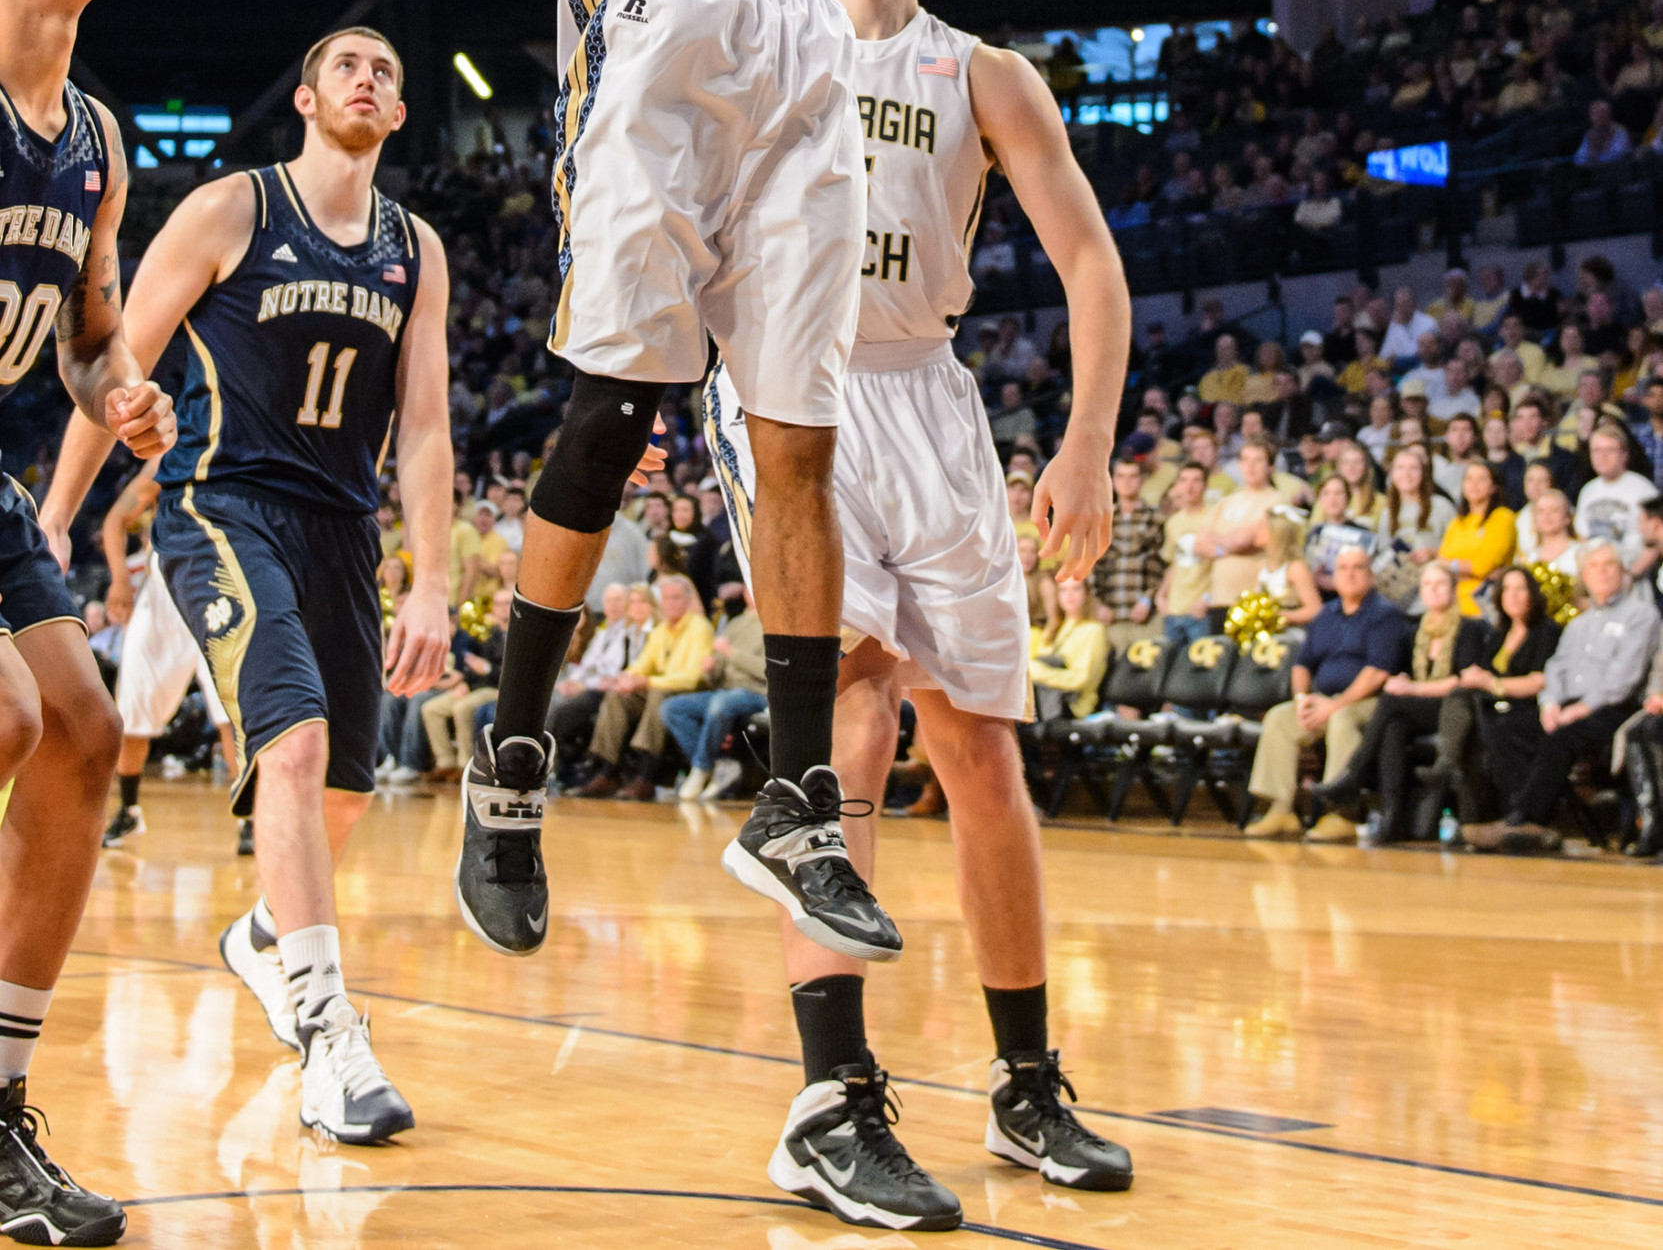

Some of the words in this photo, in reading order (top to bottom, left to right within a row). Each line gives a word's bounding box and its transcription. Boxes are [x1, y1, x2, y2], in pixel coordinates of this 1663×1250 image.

[856, 94, 937, 155] RGIA
[38, 206, 91, 273] DAM
[257, 280, 349, 324] NOTRE
[296, 341, 358, 429] 11
